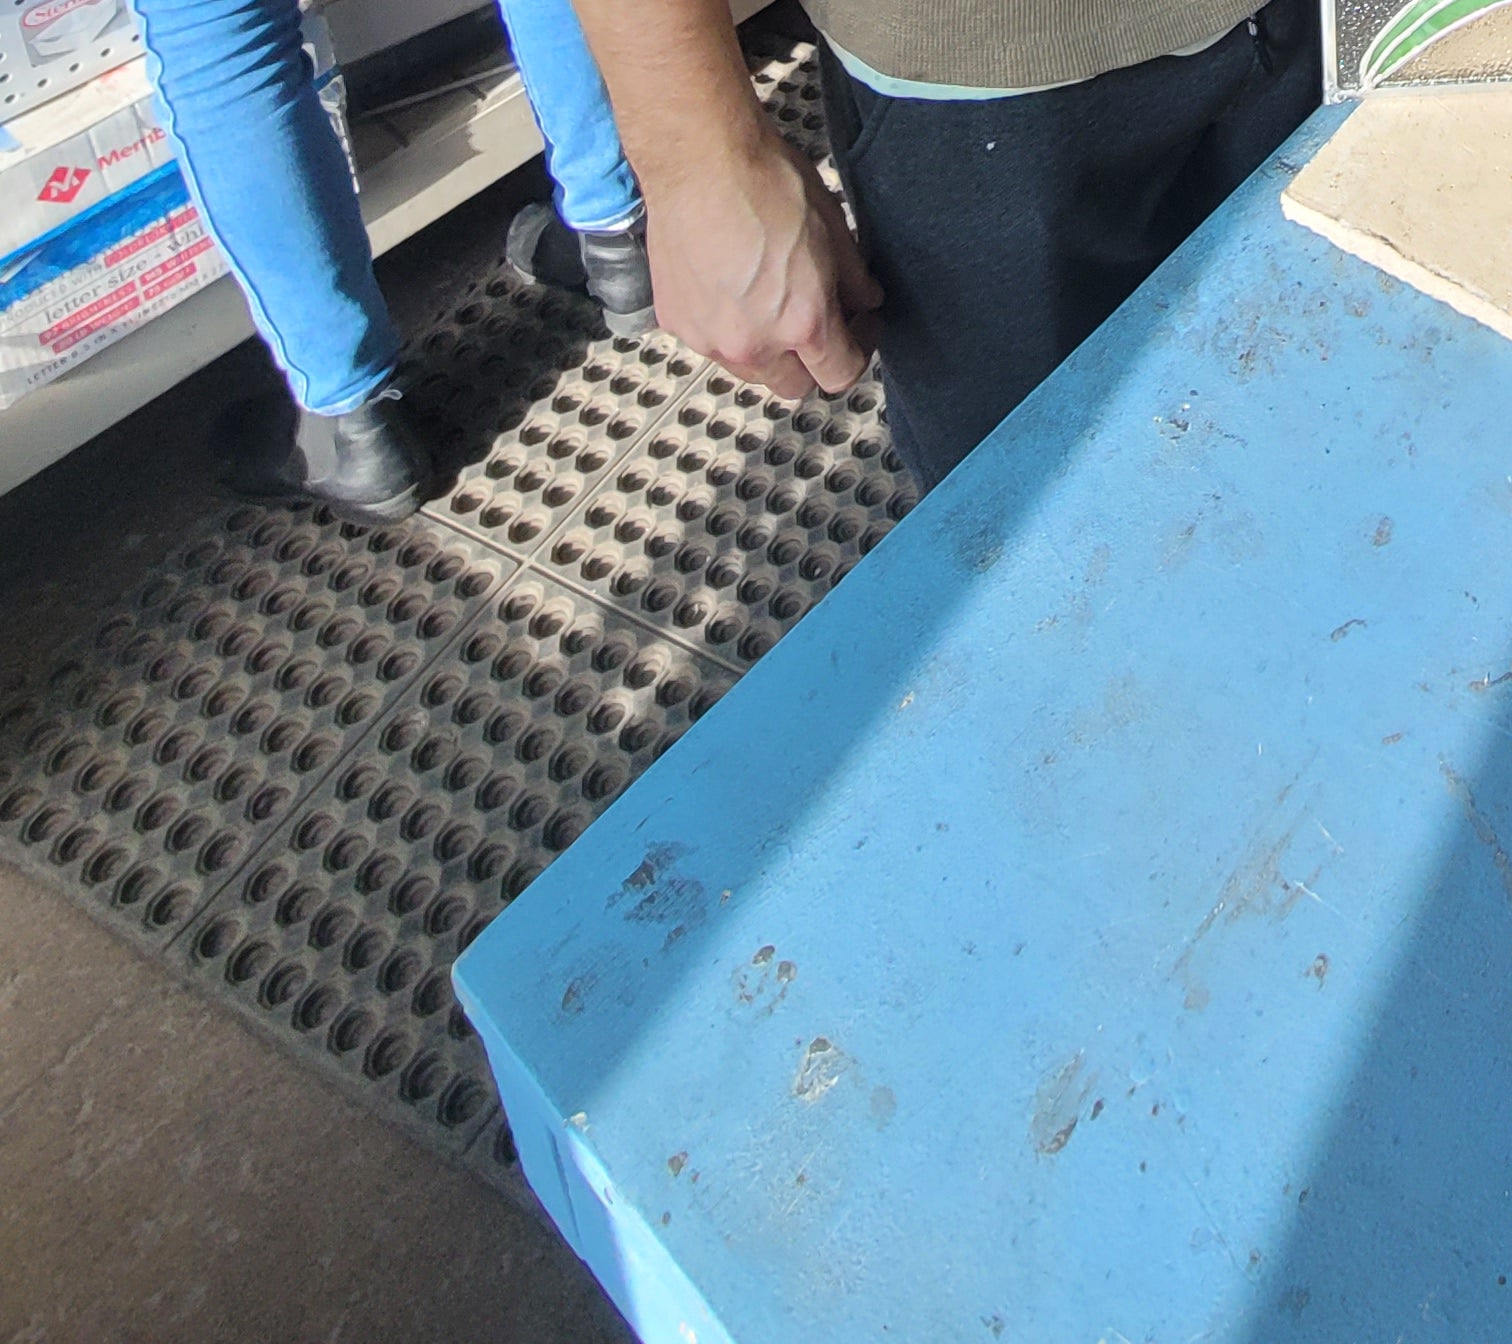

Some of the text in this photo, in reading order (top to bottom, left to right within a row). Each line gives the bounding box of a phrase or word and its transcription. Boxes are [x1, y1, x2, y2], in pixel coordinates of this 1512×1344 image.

[97, 127, 167, 170] Memb
[45, 284, 102, 324] letter
[108, 259, 148, 288] size
[167, 223, 204, 253] whi
